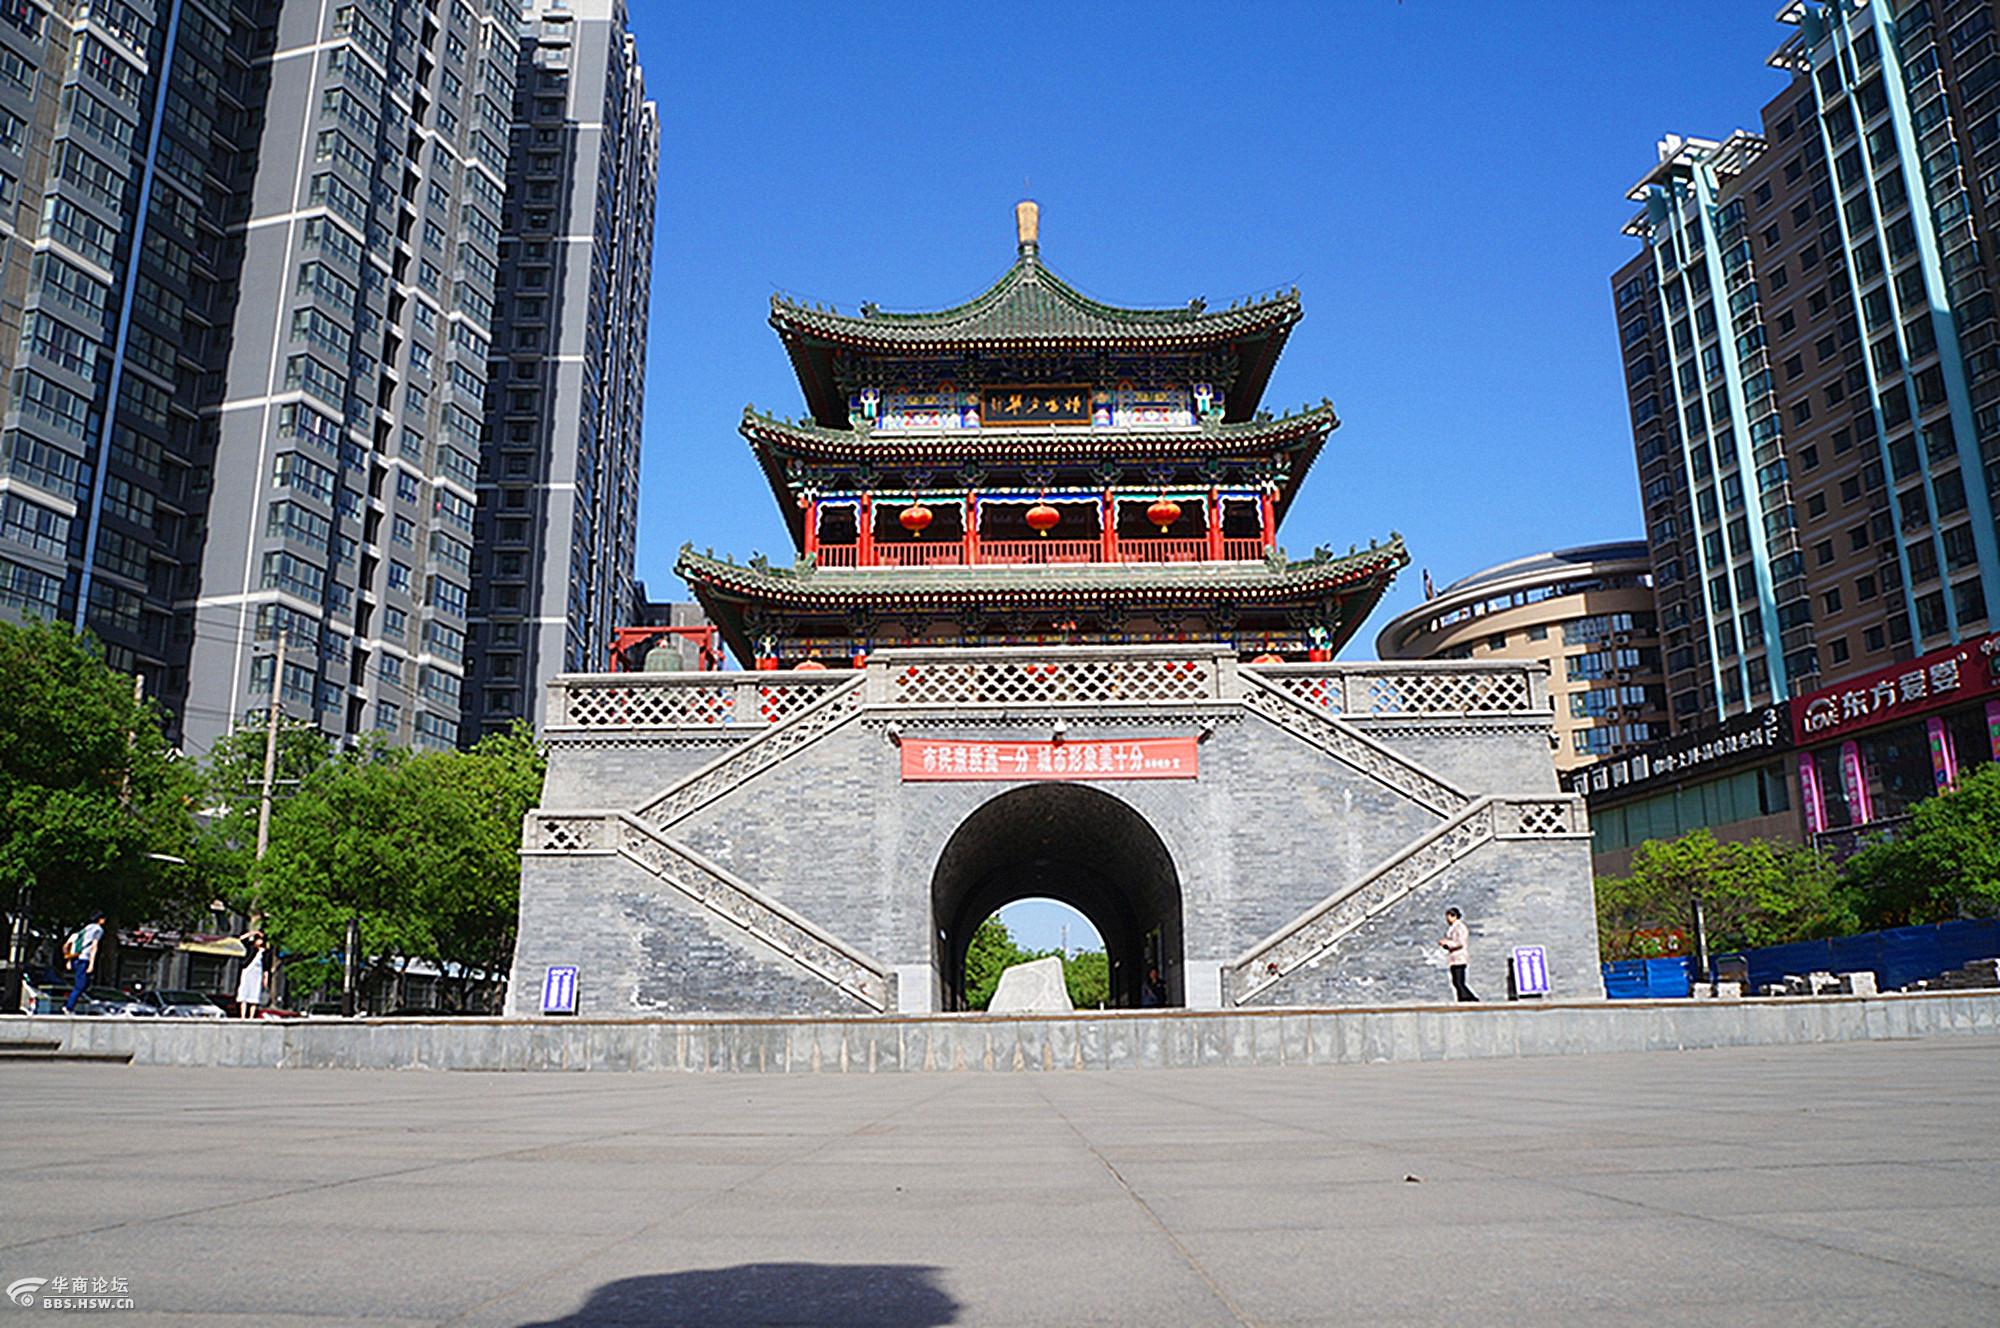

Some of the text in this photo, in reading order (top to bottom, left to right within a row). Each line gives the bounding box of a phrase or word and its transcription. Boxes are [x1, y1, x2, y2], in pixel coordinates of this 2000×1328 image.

[1036, 745, 1144, 772] 城市形象美十分
